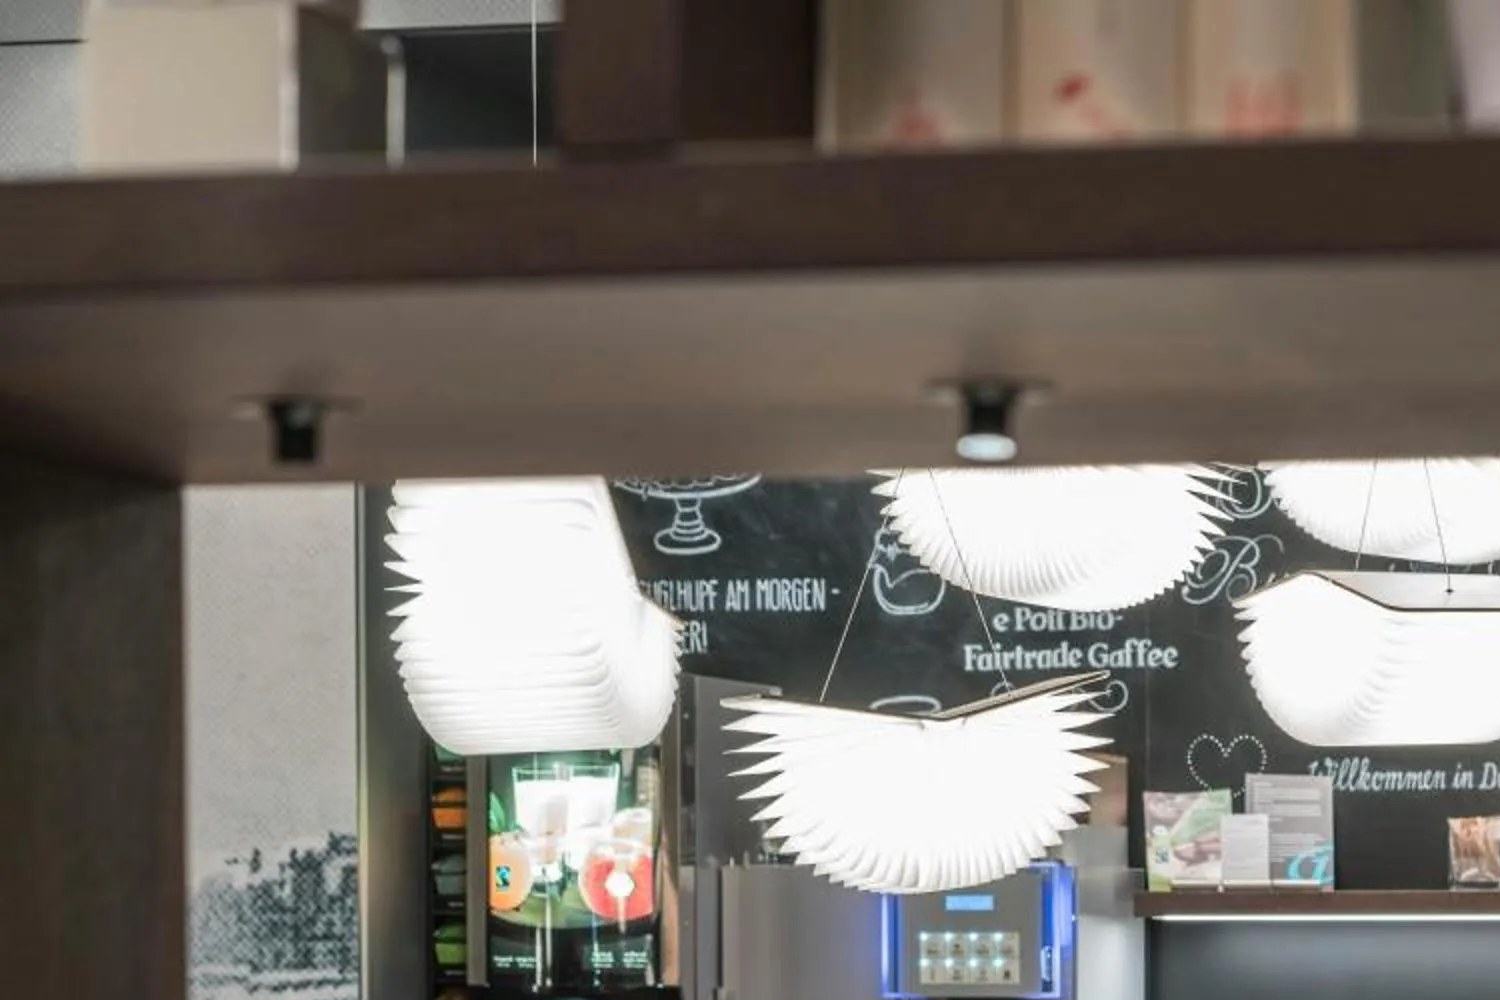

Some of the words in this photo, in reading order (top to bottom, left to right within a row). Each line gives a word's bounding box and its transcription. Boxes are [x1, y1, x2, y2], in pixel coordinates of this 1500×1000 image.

[725, 579, 750, 612] AM
[755, 578, 827, 612] MORGEN
[963, 640, 1083, 672] Fairtrade
[1087, 638, 1179, 669] Gaffee
[1452, 762, 1473, 789] in
